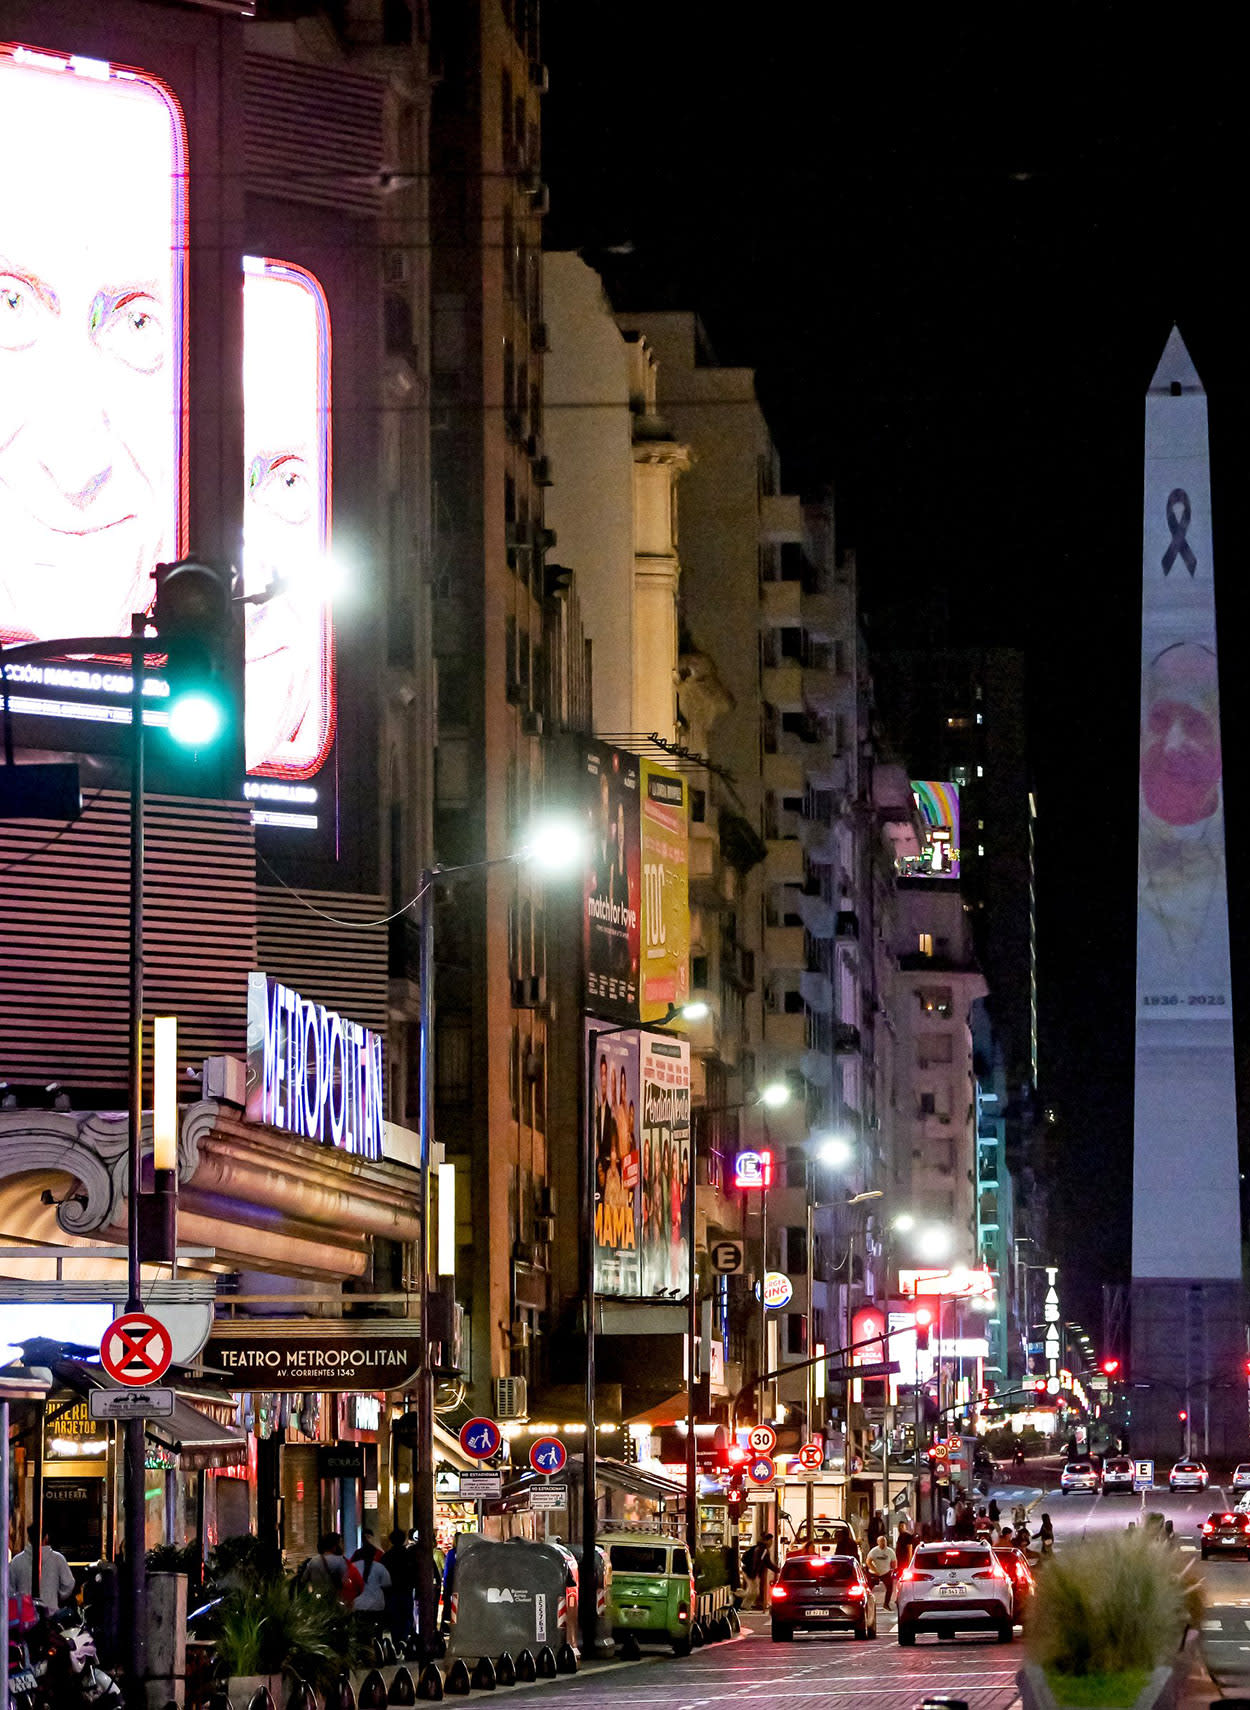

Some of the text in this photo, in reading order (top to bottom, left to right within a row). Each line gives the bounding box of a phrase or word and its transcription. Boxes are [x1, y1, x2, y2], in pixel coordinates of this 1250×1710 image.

[588, 894, 611, 921] match
[621, 901, 636, 928] love
[643, 863, 666, 946] TOC
[262, 983, 385, 1162] METROPOLITAN
[594, 1191, 636, 1250] MAMÁ
[717, 1247, 737, 1270] E
[221, 1350, 408, 1366] TEATRO METROPOLITAN
[277, 1369, 356, 1377] AV. CORRIENTES 1343
[754, 1433, 770, 1446] 30
[936, 1447, 945, 1455] 30
[1140, 1463, 1148, 1475] E
[487, 1587, 514, 1603] BA
